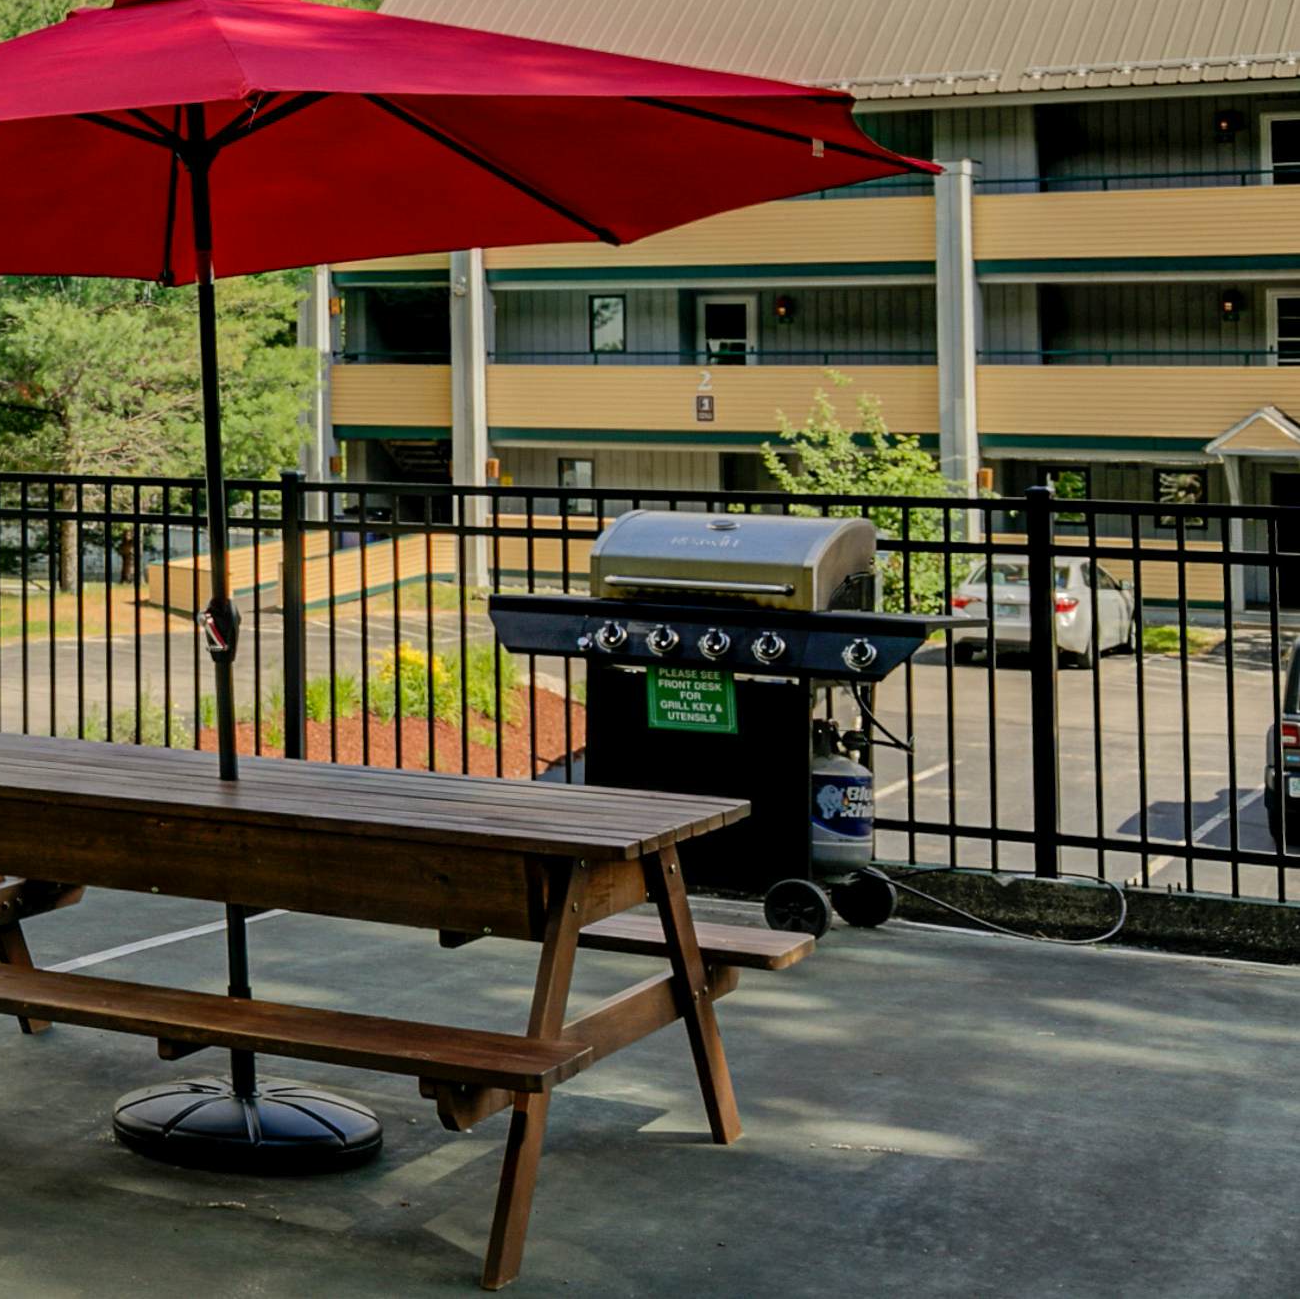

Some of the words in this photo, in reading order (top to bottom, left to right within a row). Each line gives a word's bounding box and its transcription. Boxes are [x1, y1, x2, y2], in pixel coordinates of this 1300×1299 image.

[696, 371, 712, 391] 2
[659, 668, 698, 679] PLEASE
[701, 670, 721, 680] SEE
[658, 679, 691, 690] FRONT
[694, 682, 722, 692] DESK
[680, 691, 701, 701] FOR
[660, 700, 690, 711] GRILL
[692, 702, 712, 712] KEY
[715, 704, 722, 713] &
[667, 711, 717, 723] UTENSILS
[847, 786, 873, 801] Blu
